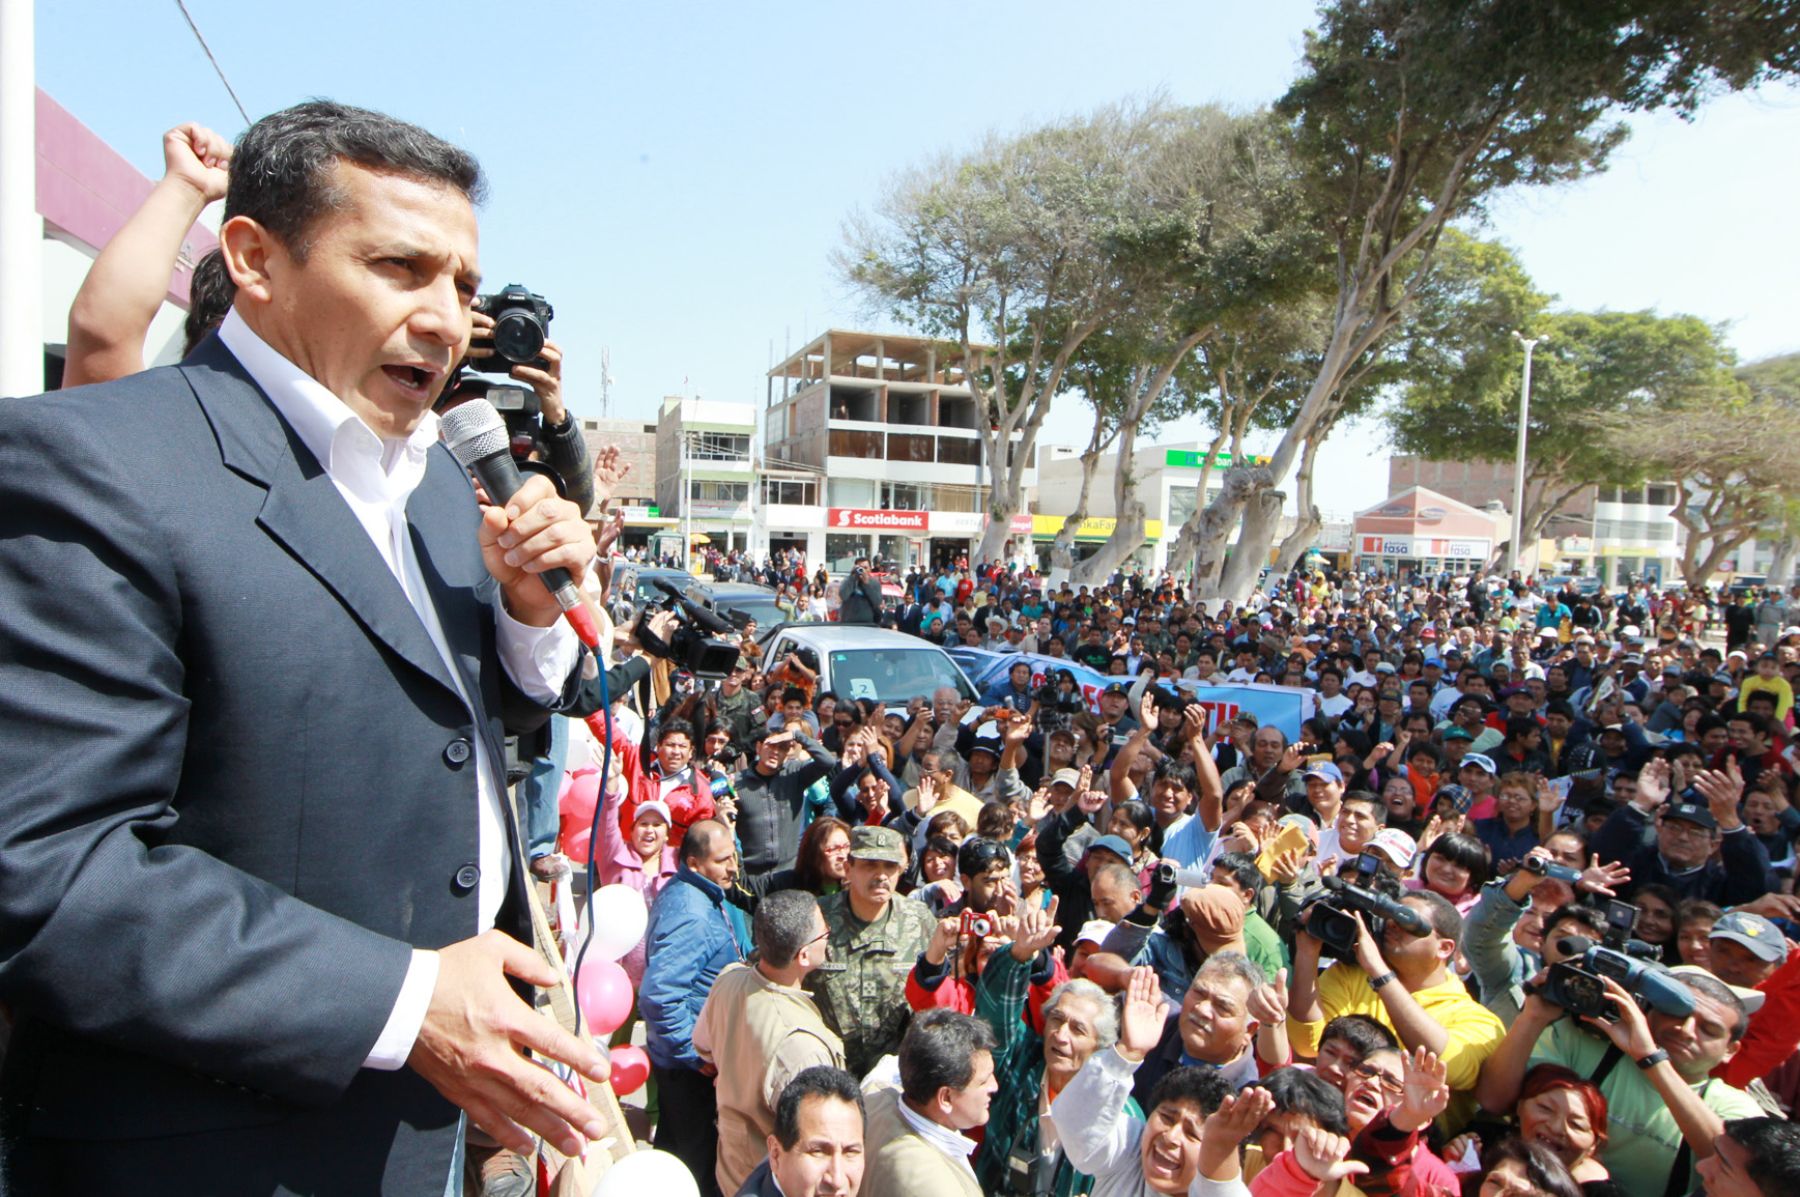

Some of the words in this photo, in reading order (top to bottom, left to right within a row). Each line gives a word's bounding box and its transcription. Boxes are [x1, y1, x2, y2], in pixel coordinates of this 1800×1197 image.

[853, 513, 922, 527] Scotiabank
[1383, 542, 1409, 554] fasa
[1450, 543, 1471, 556] fasa
[859, 684, 869, 693] 2
